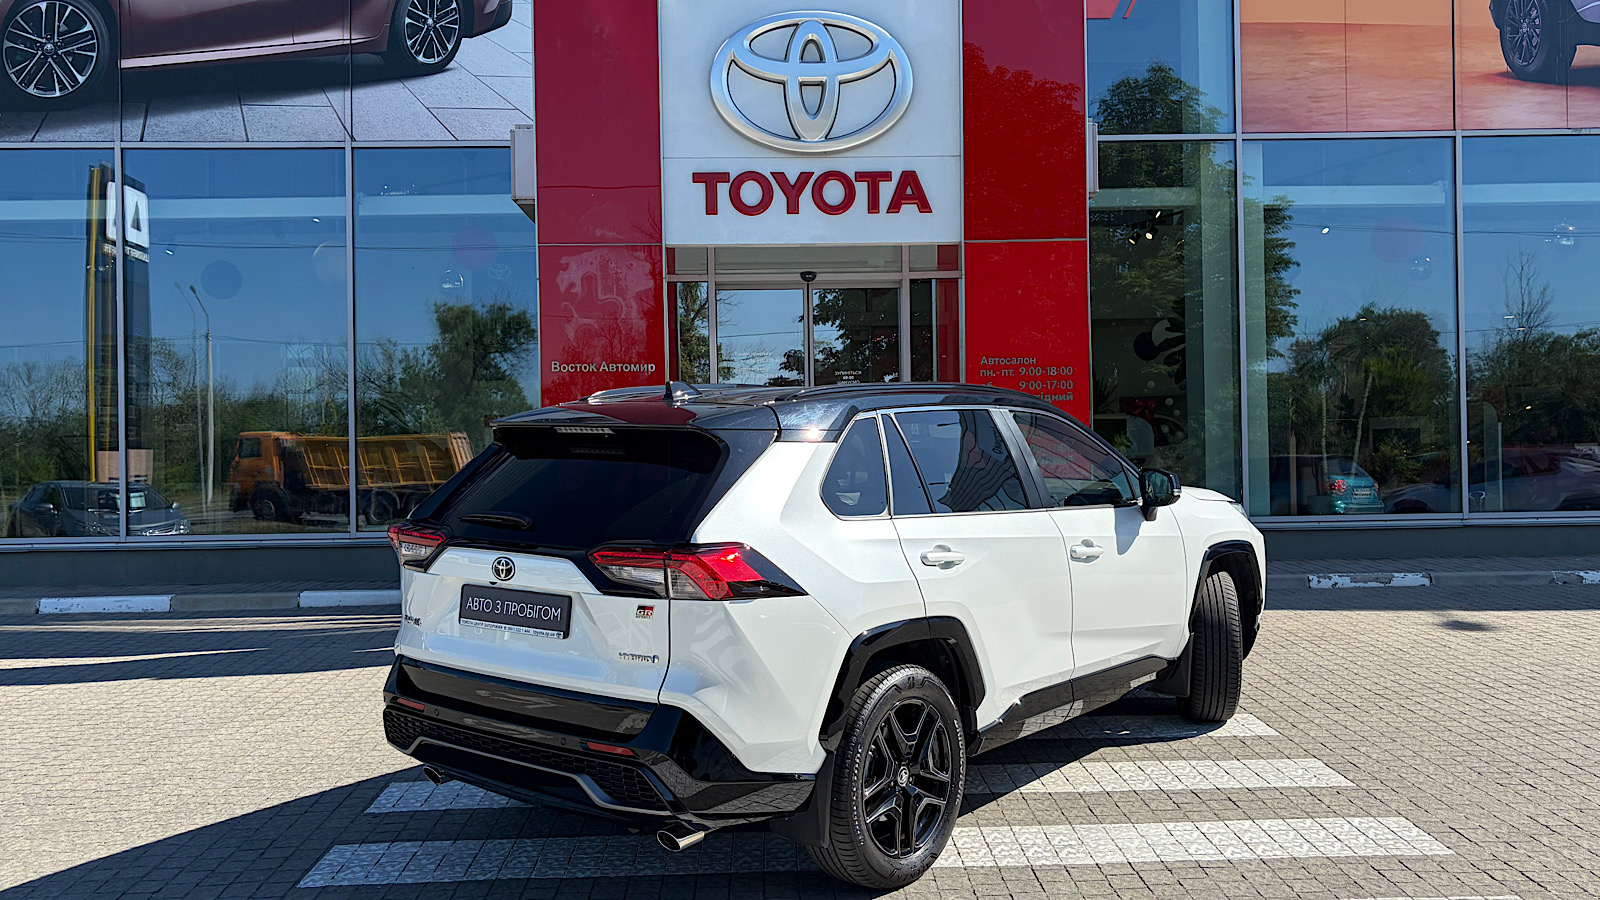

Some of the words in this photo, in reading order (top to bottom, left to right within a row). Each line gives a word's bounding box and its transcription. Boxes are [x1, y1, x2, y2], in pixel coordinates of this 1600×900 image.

[692, 170, 933, 216] TOYOTA
[980, 355, 1037, 365] Автосалон
[551, 361, 597, 373] Восток
[599, 361, 656, 374] Автомир
[465, 597, 493, 613] АВТО
[503, 601, 562, 622] ПРОБІГОМ
[637, 609, 654, 617] GR
